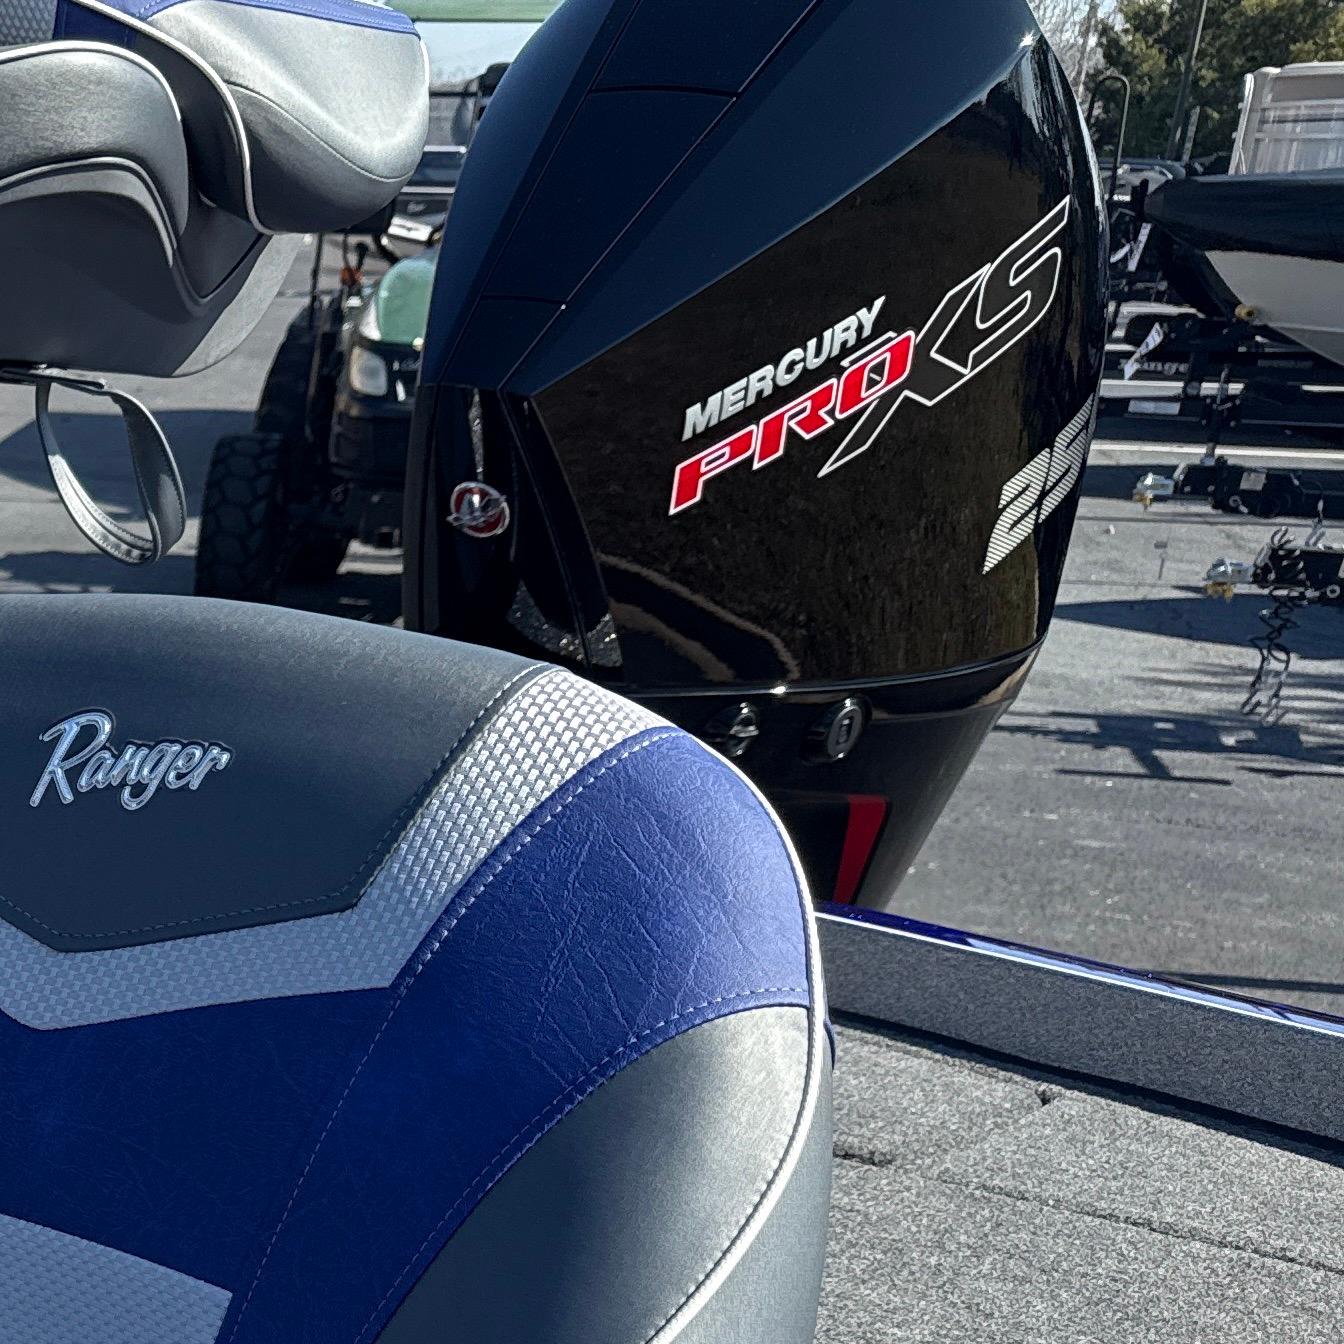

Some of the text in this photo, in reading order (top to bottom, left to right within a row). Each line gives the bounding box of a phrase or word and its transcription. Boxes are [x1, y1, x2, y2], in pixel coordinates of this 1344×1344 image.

[668, 194, 1071, 516] PRO XS
[681, 295, 886, 442] MERCURY
[29, 711, 231, 811] Ranger
